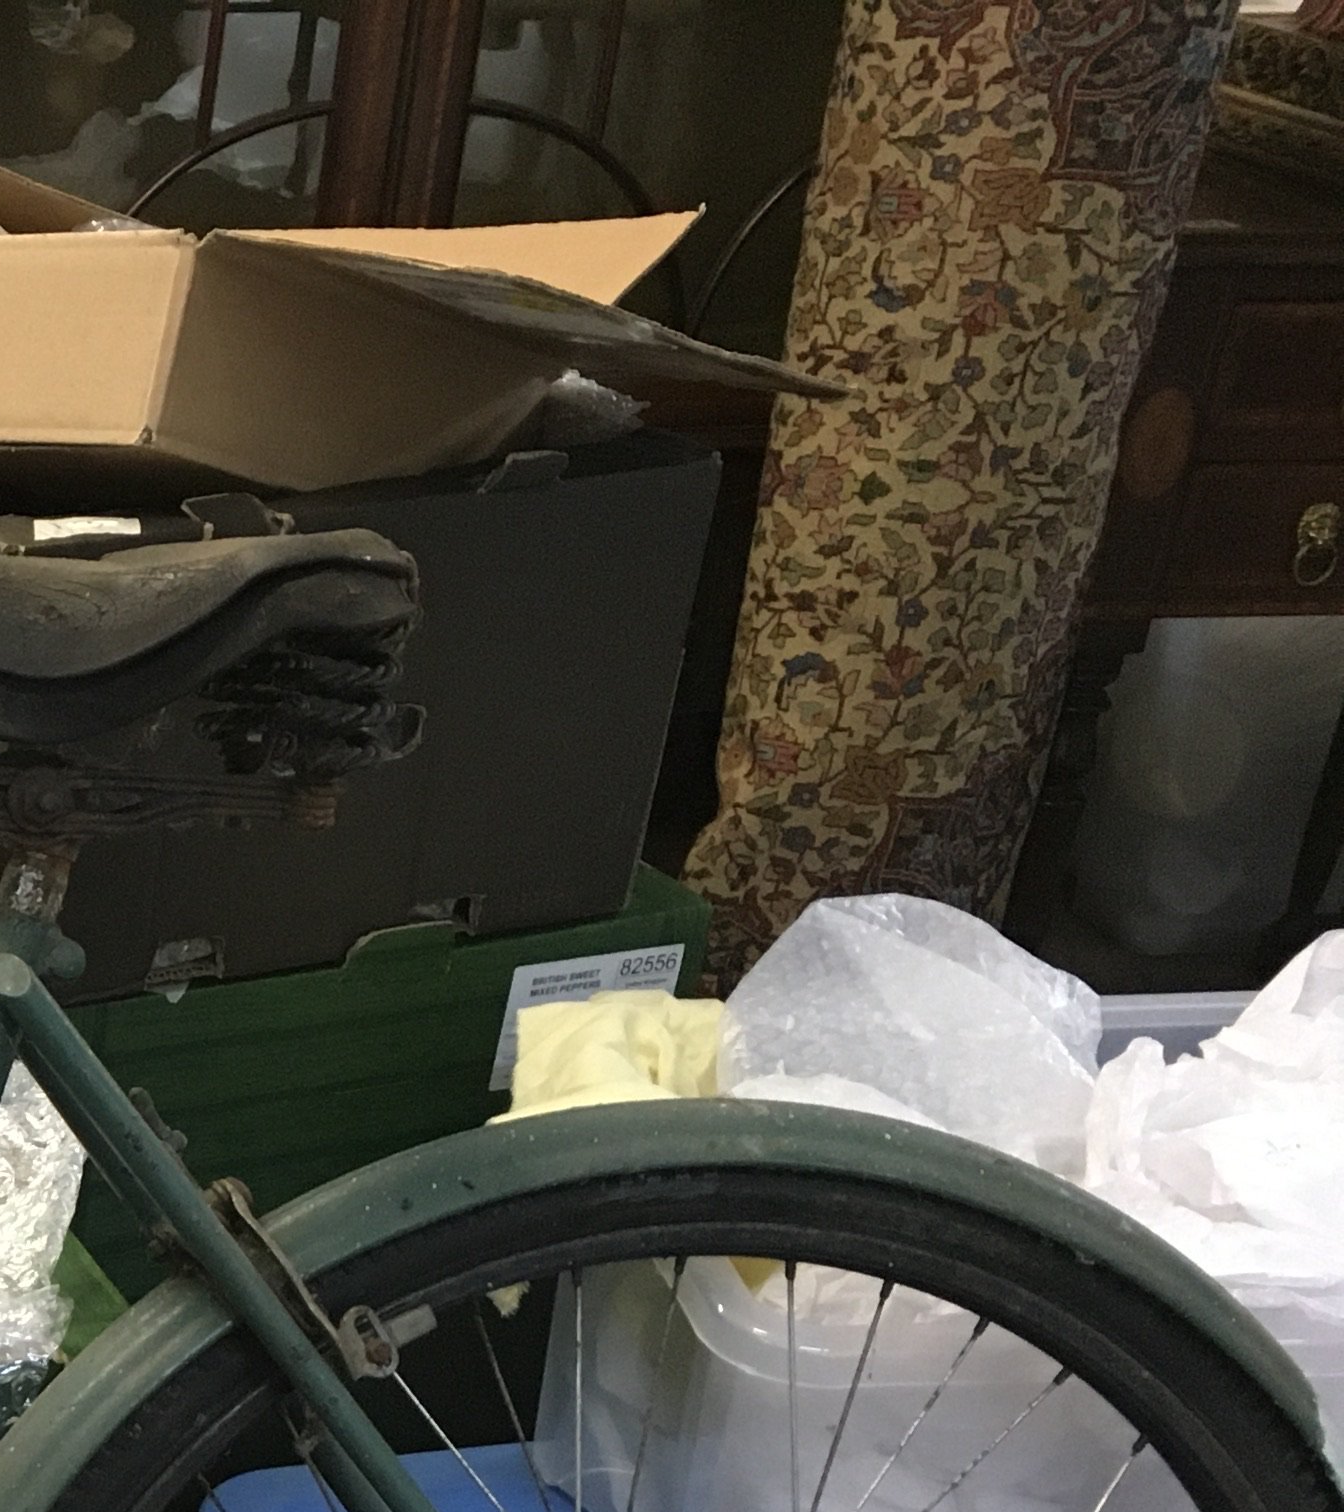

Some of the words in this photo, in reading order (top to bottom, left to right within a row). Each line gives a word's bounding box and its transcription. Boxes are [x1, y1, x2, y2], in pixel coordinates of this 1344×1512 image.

[620, 952, 678, 976] 82556
[532, 974, 567, 986] BRITISH
[569, 969, 602, 981] SWEET
[529, 985, 558, 997] MIXED
[559, 979, 602, 993] PEPPERS
